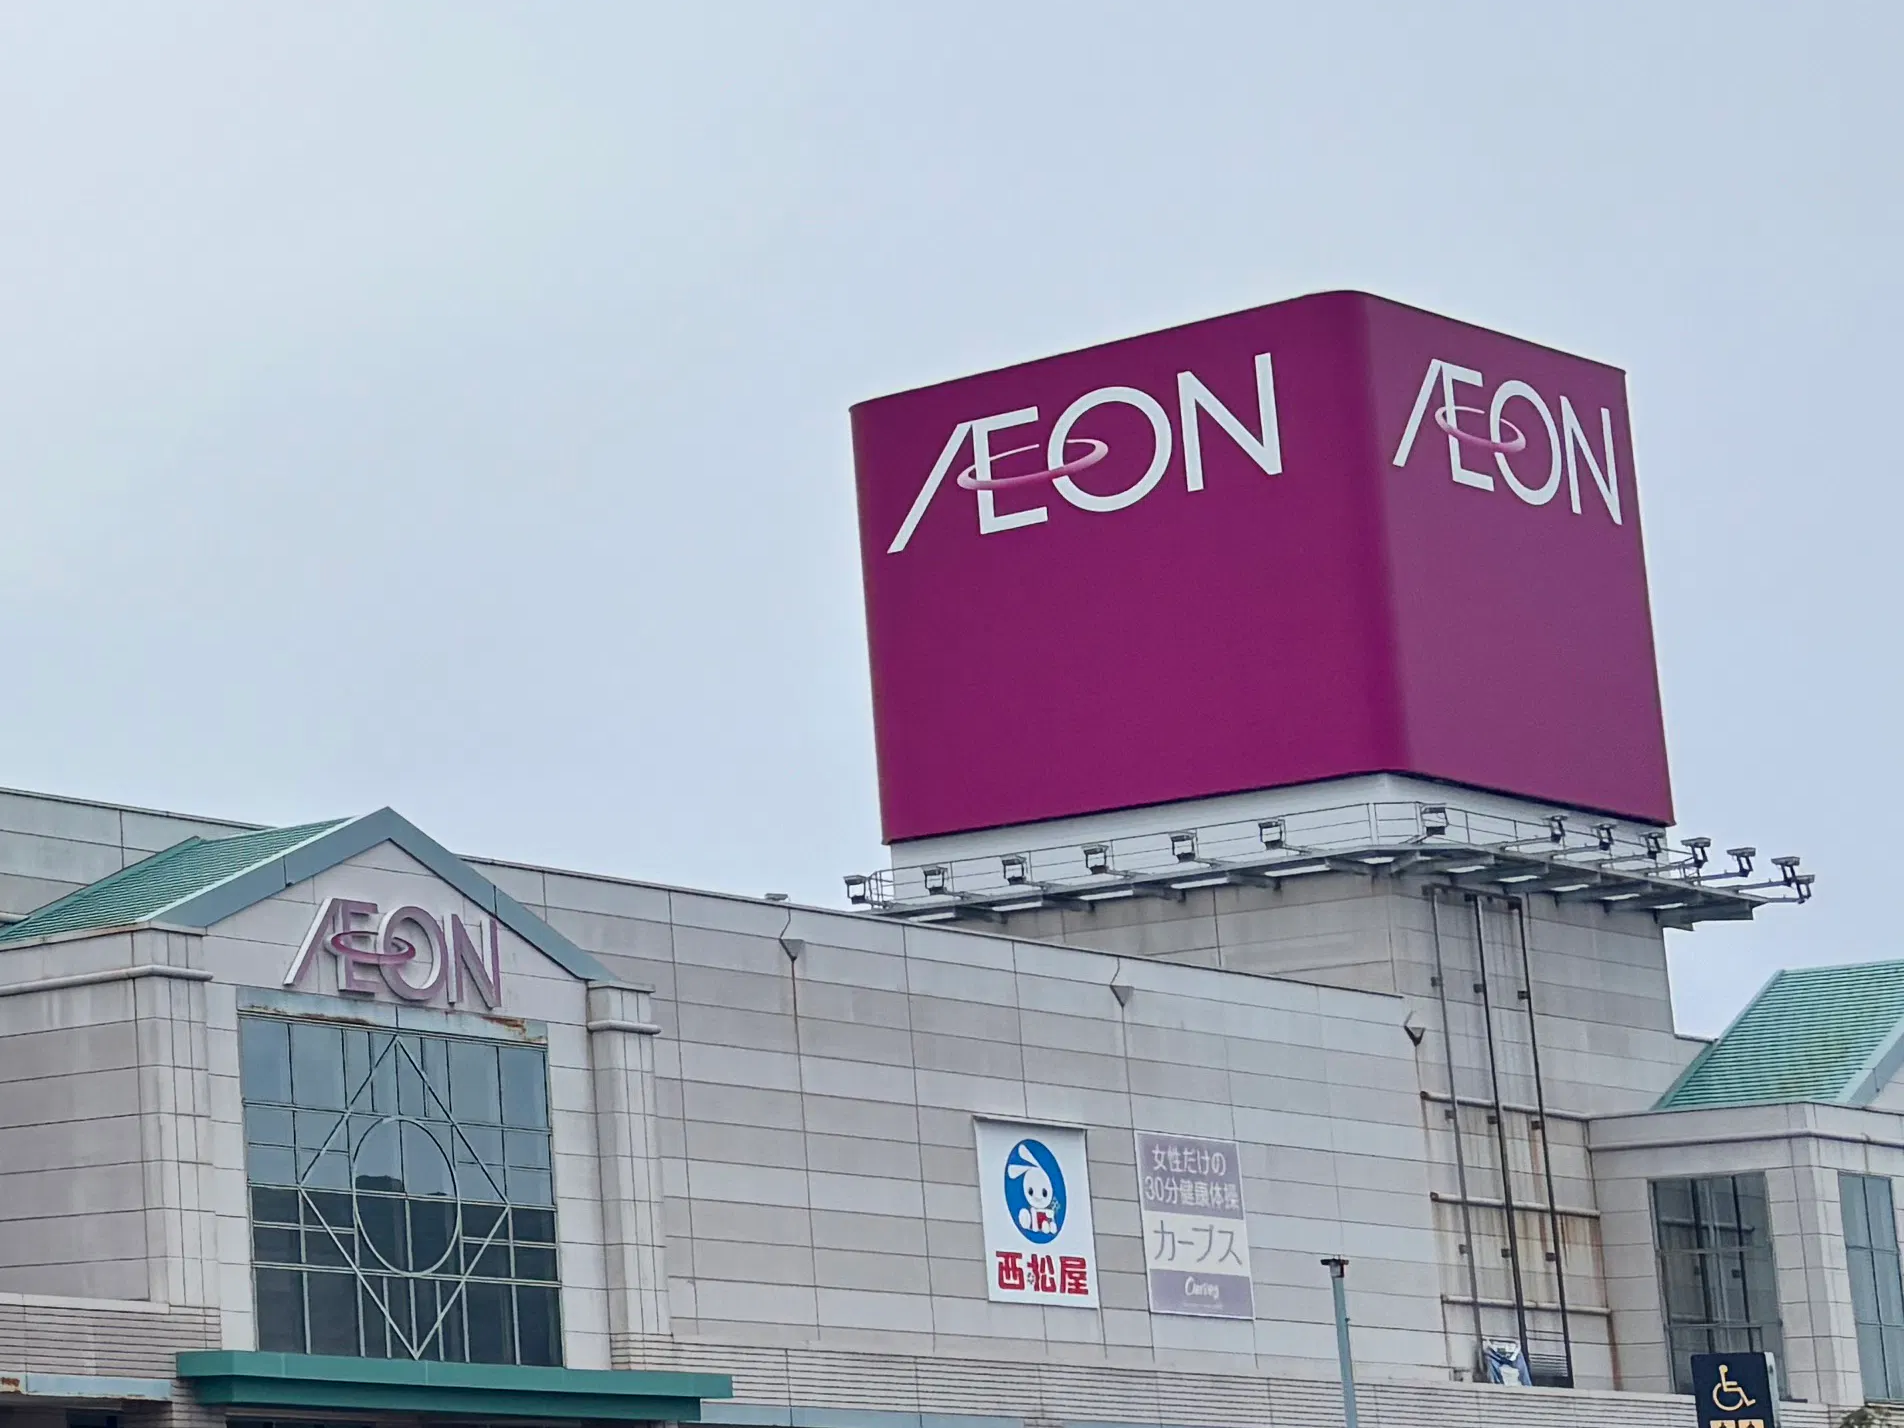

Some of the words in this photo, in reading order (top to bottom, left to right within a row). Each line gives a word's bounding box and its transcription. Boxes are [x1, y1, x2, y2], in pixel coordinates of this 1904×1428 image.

[1151, 1143, 1227, 1177] 女性だけの
[1144, 1175, 1241, 1211] 30分健康体操
[995, 1250, 1089, 1296] 西松屋
